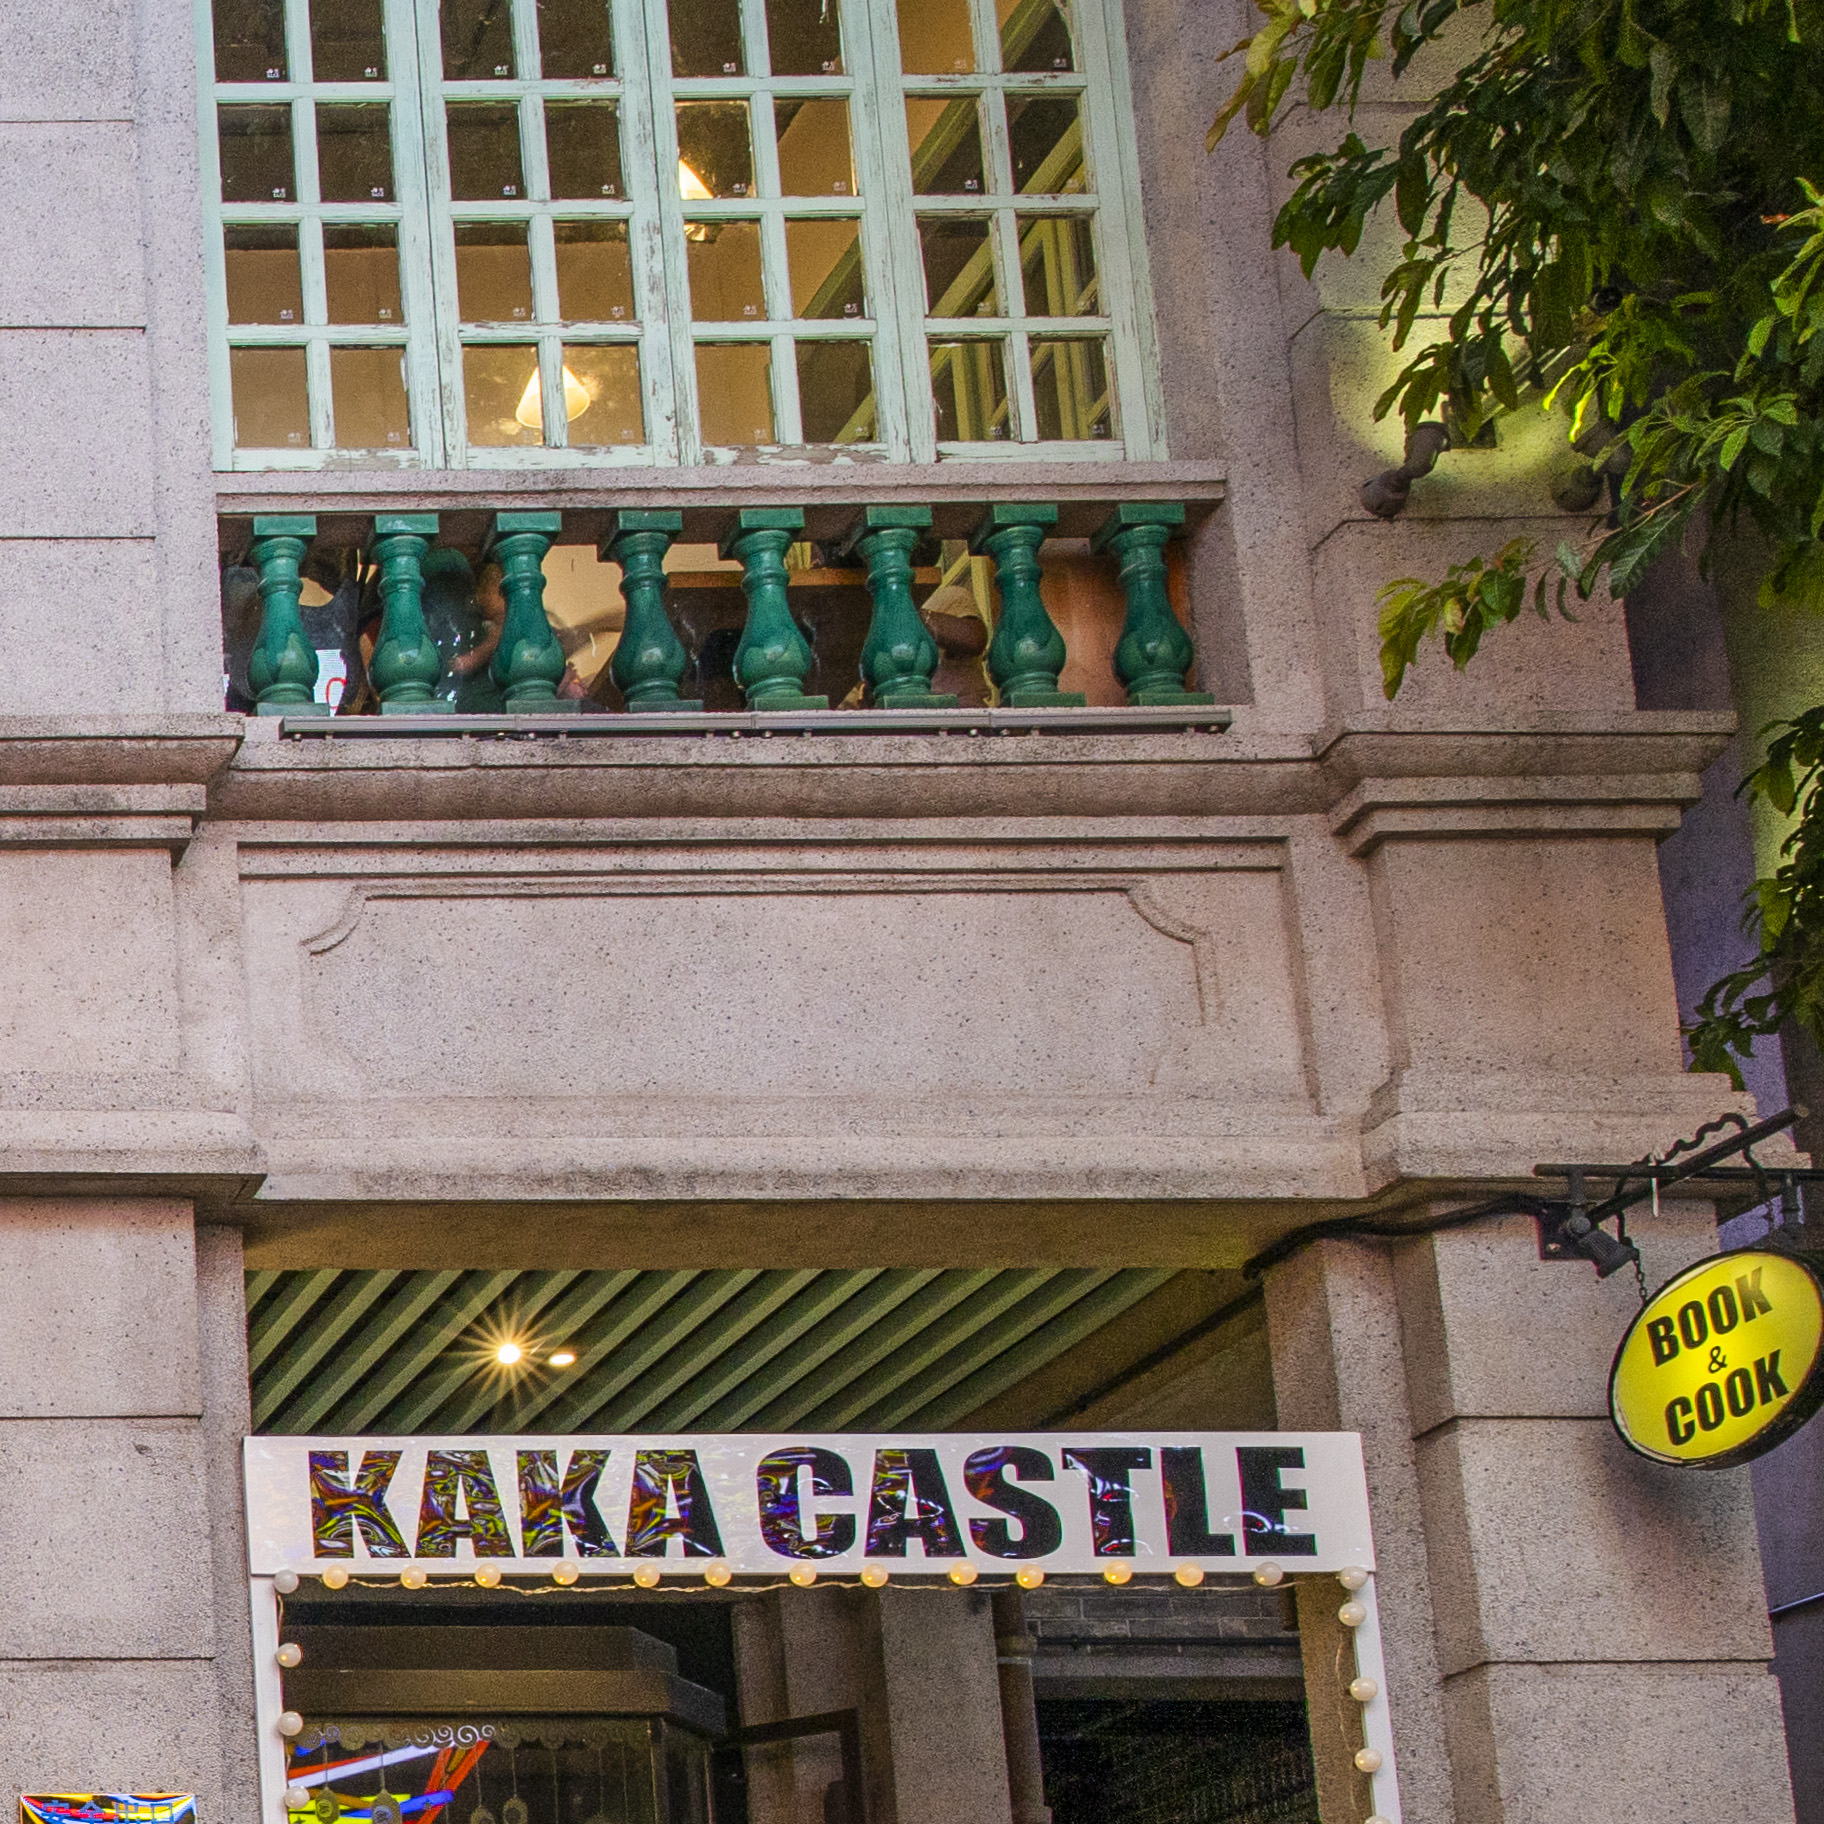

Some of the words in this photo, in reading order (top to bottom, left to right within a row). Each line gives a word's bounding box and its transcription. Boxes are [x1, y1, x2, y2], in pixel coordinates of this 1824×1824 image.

[1646, 1266, 1773, 1367] BOOK
[1708, 1346, 1727, 1374] &
[1664, 1349, 1789, 1446] COOK
[307, 1448, 726, 1558] KAKA
[757, 1445, 1317, 1559] CASTLE
